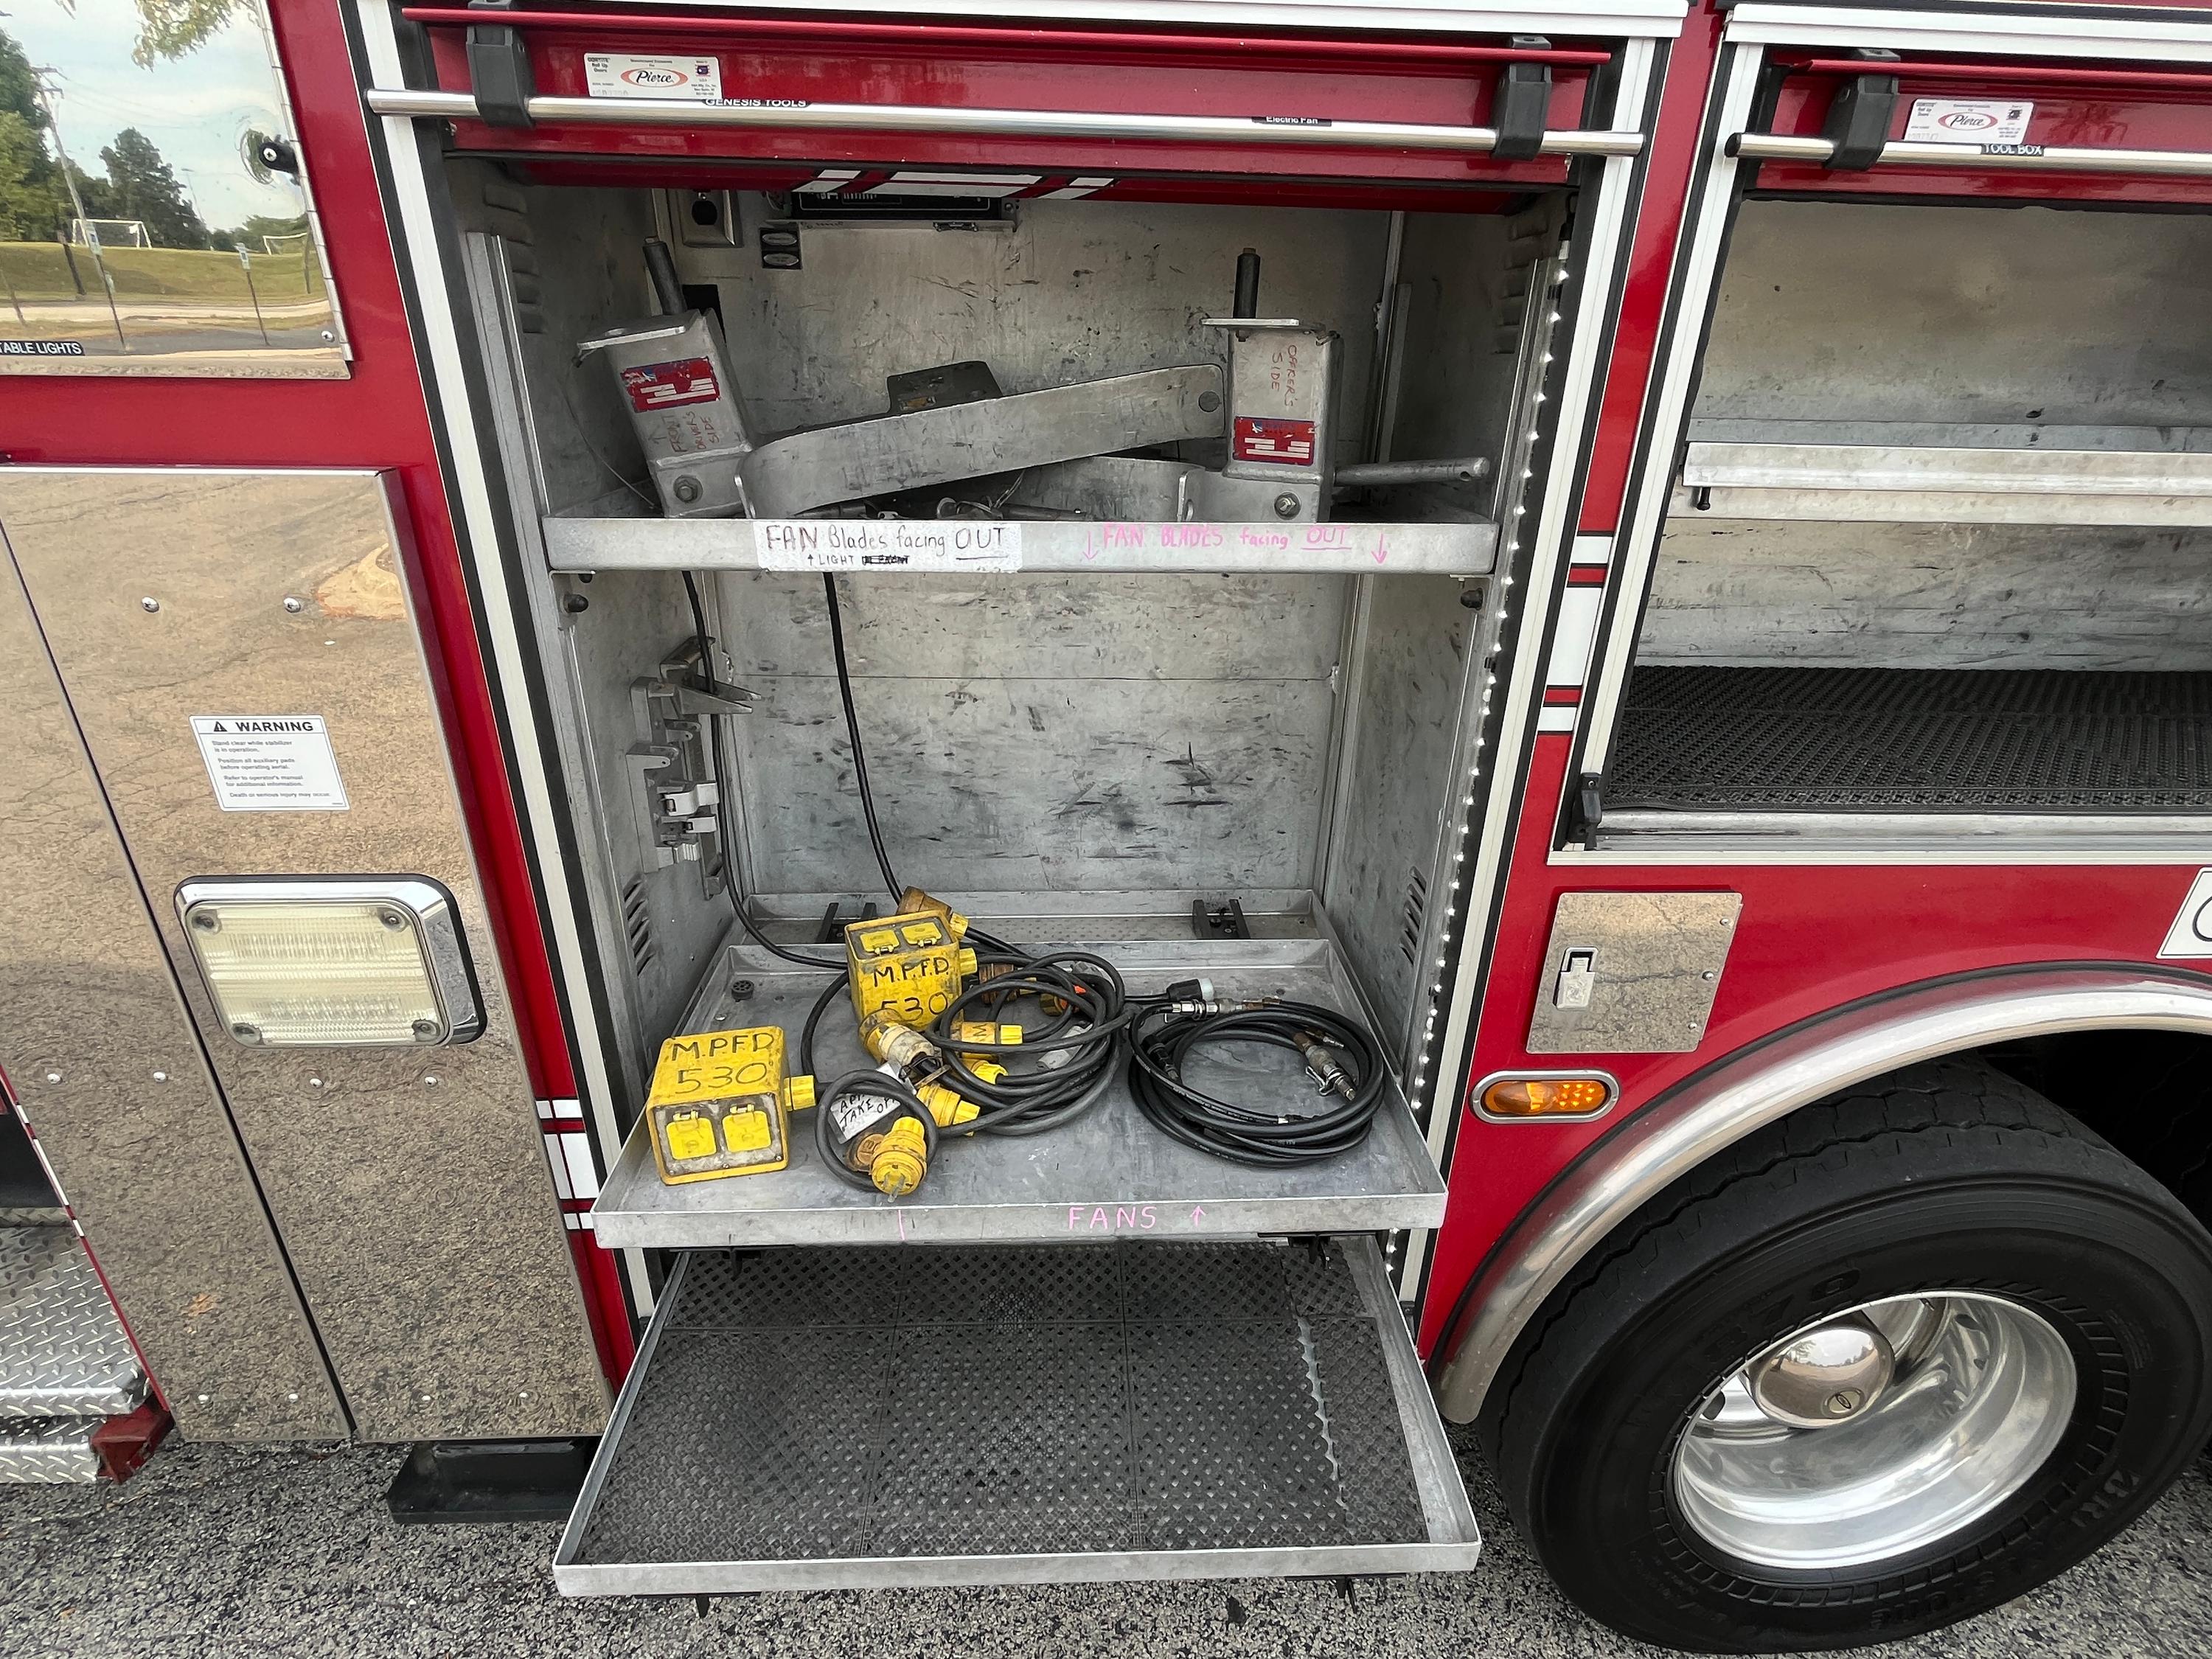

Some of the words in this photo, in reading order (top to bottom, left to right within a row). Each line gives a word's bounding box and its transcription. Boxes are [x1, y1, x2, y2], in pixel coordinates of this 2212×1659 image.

[636, 70, 672, 83] Pierce
[705, 98, 761, 107] GENESIS
[764, 100, 807, 108] TOOLS
[1266, 116, 1298, 124] Electric
[1950, 114, 1984, 128] Pierce
[1984, 144, 2014, 154] TOOL
[2017, 145, 2042, 155] BOX
[35, 342, 82, 354] LIGHTS
[1270, 352, 1283, 392] SIDE
[702, 417, 720, 443] SIDE
[766, 525, 817, 551] FAN
[828, 524, 888, 549] Blades
[897, 525, 945, 557] facing
[956, 527, 1005, 550] OUT
[1103, 524, 1144, 549] FAN
[1161, 524, 1223, 547] BLADES
[1240, 526, 1289, 550] facing
[1307, 526, 1351, 544] OUT
[818, 554, 854, 566] LIGHT
[235, 721, 313, 732] WARNING
[675, 1062, 767, 1093] 530
[840, 1099, 873, 1127] TAKE
[1068, 1206, 1157, 1229] FANS
